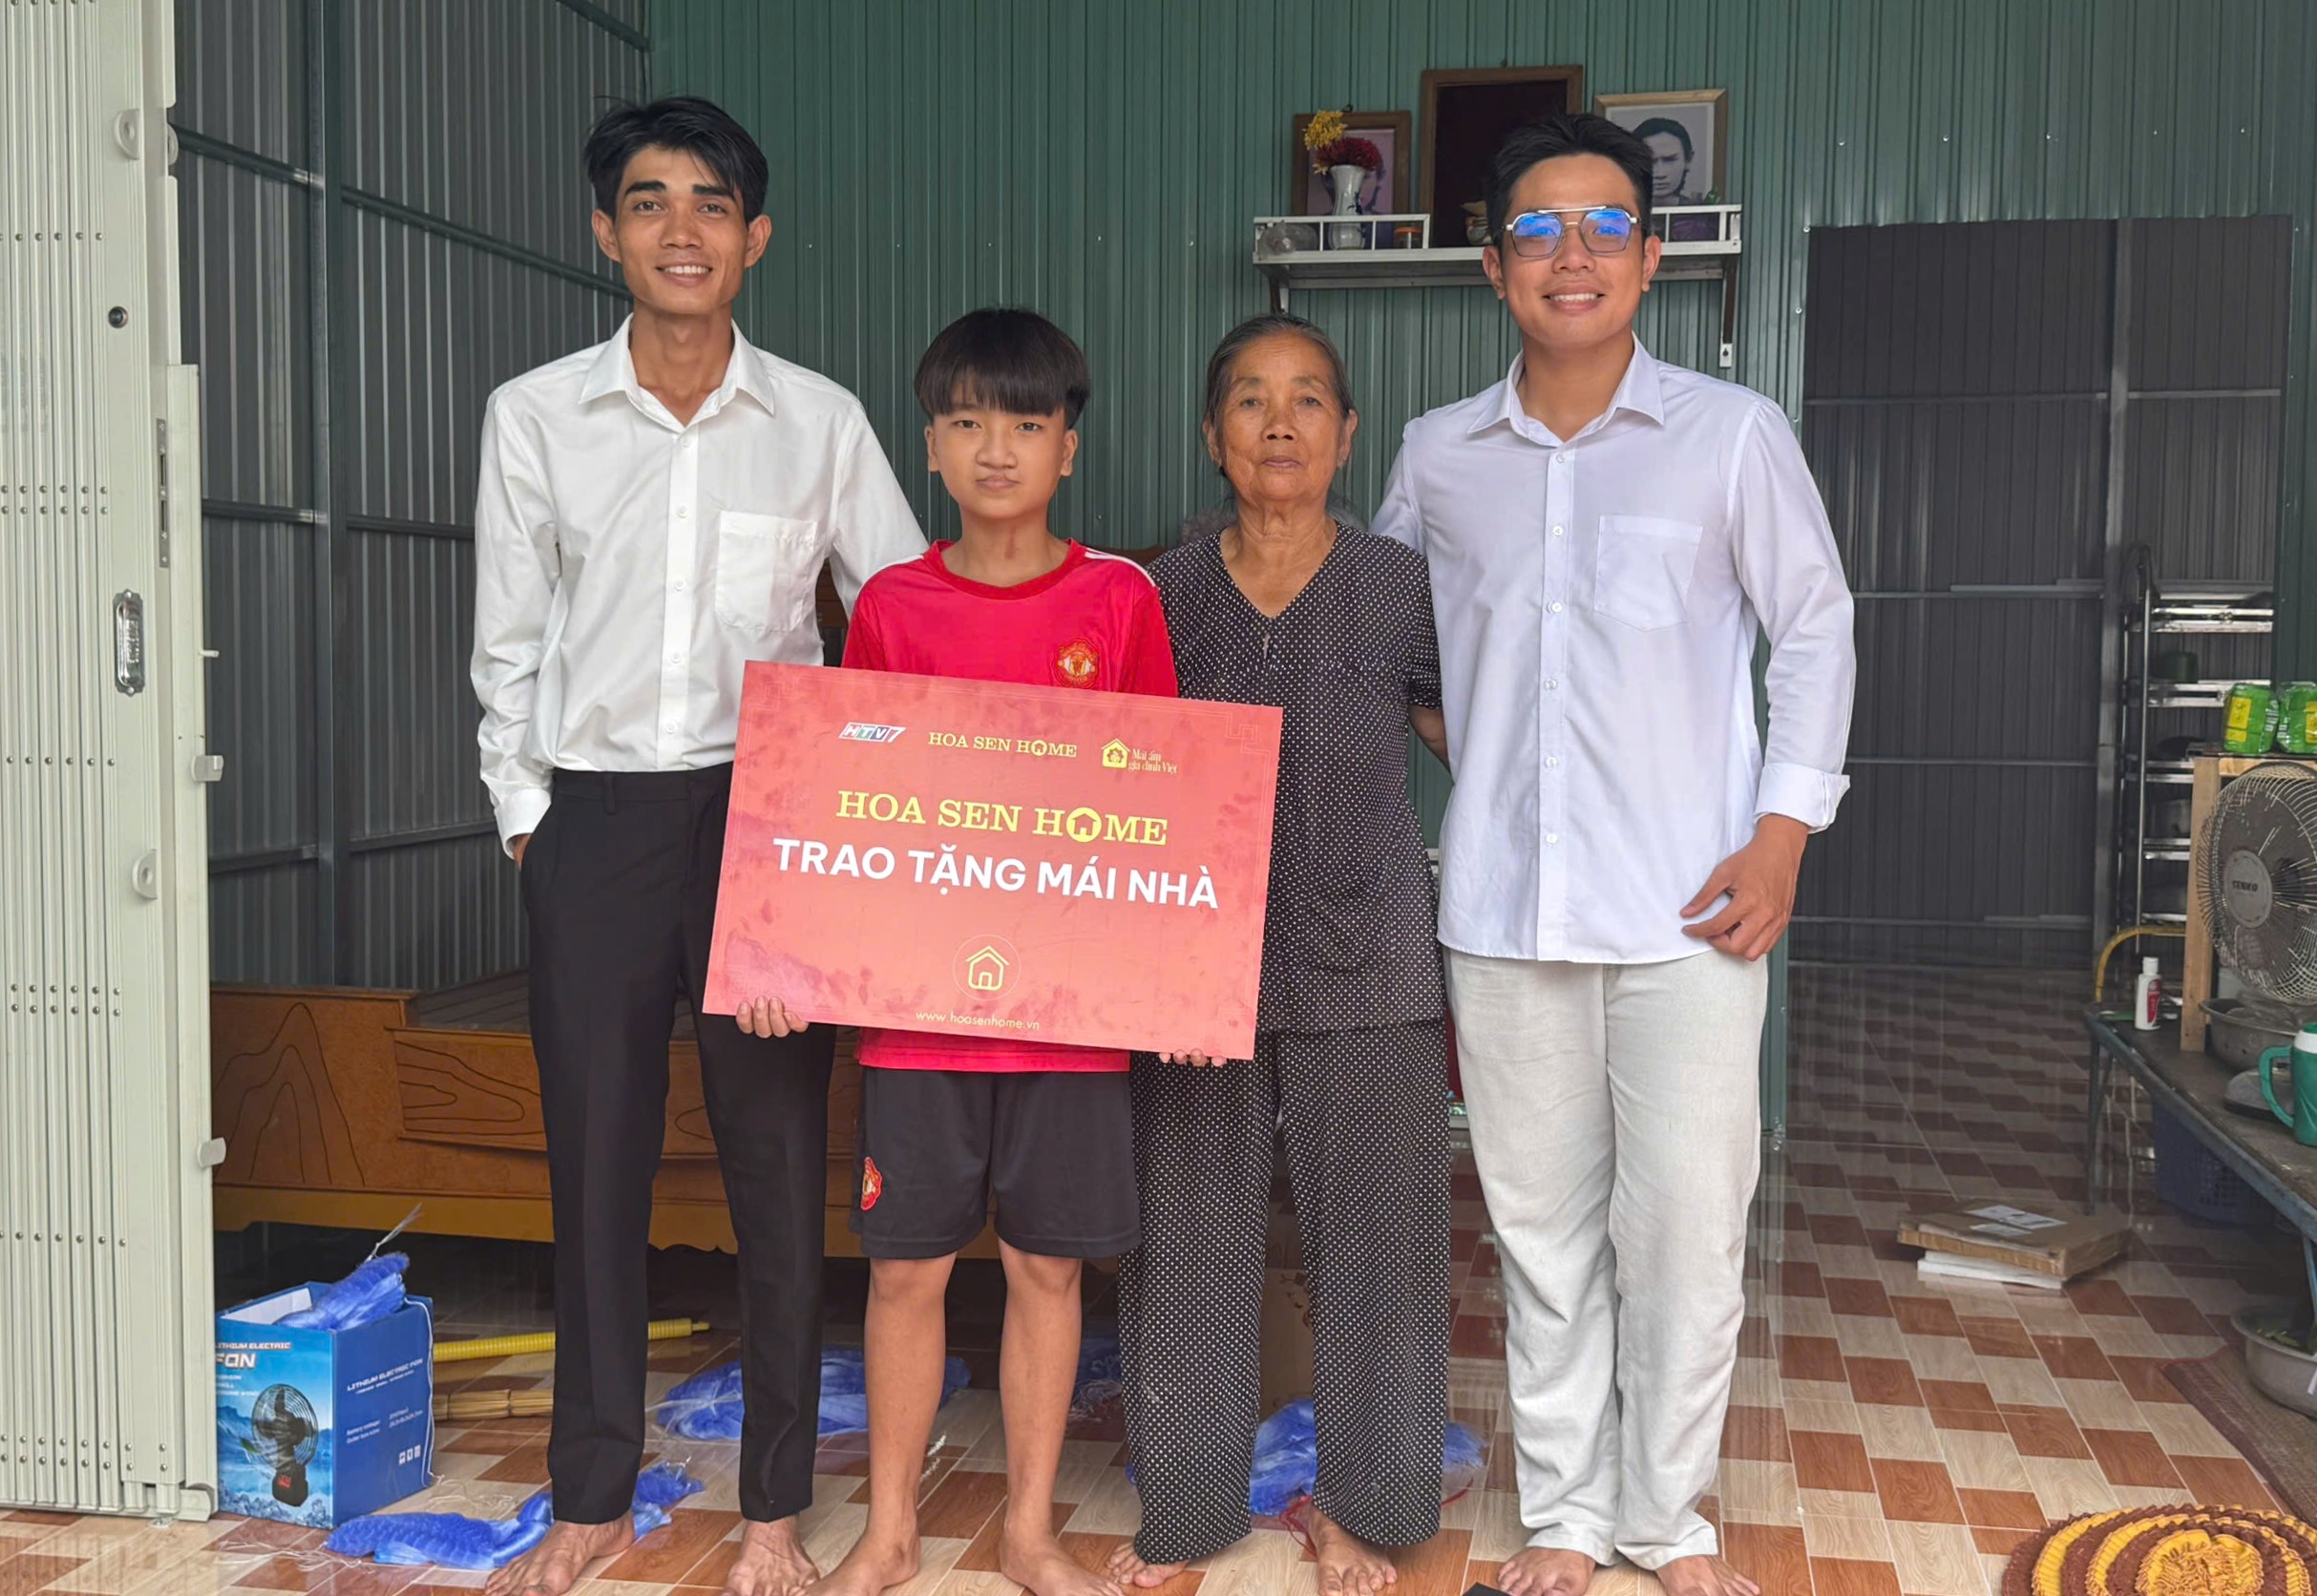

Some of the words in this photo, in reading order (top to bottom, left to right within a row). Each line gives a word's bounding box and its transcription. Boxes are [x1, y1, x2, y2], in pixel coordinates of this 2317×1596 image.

[839, 722, 907, 744] HTV7
[928, 732, 969, 748] HOA
[973, 737, 1011, 752] SEN
[1016, 739, 1077, 757] HOME
[836, 790, 926, 825] HOA
[937, 799, 1022, 832] SEN
[1032, 807, 1168, 846] HOME
[772, 837, 895, 880] TRAO
[907, 843, 1026, 895] TẶNG
[1037, 855, 1117, 899] MÁI
[1127, 865, 1219, 909] NHÀ
[916, 1010, 1040, 1030] www.hoasenhome.vn
